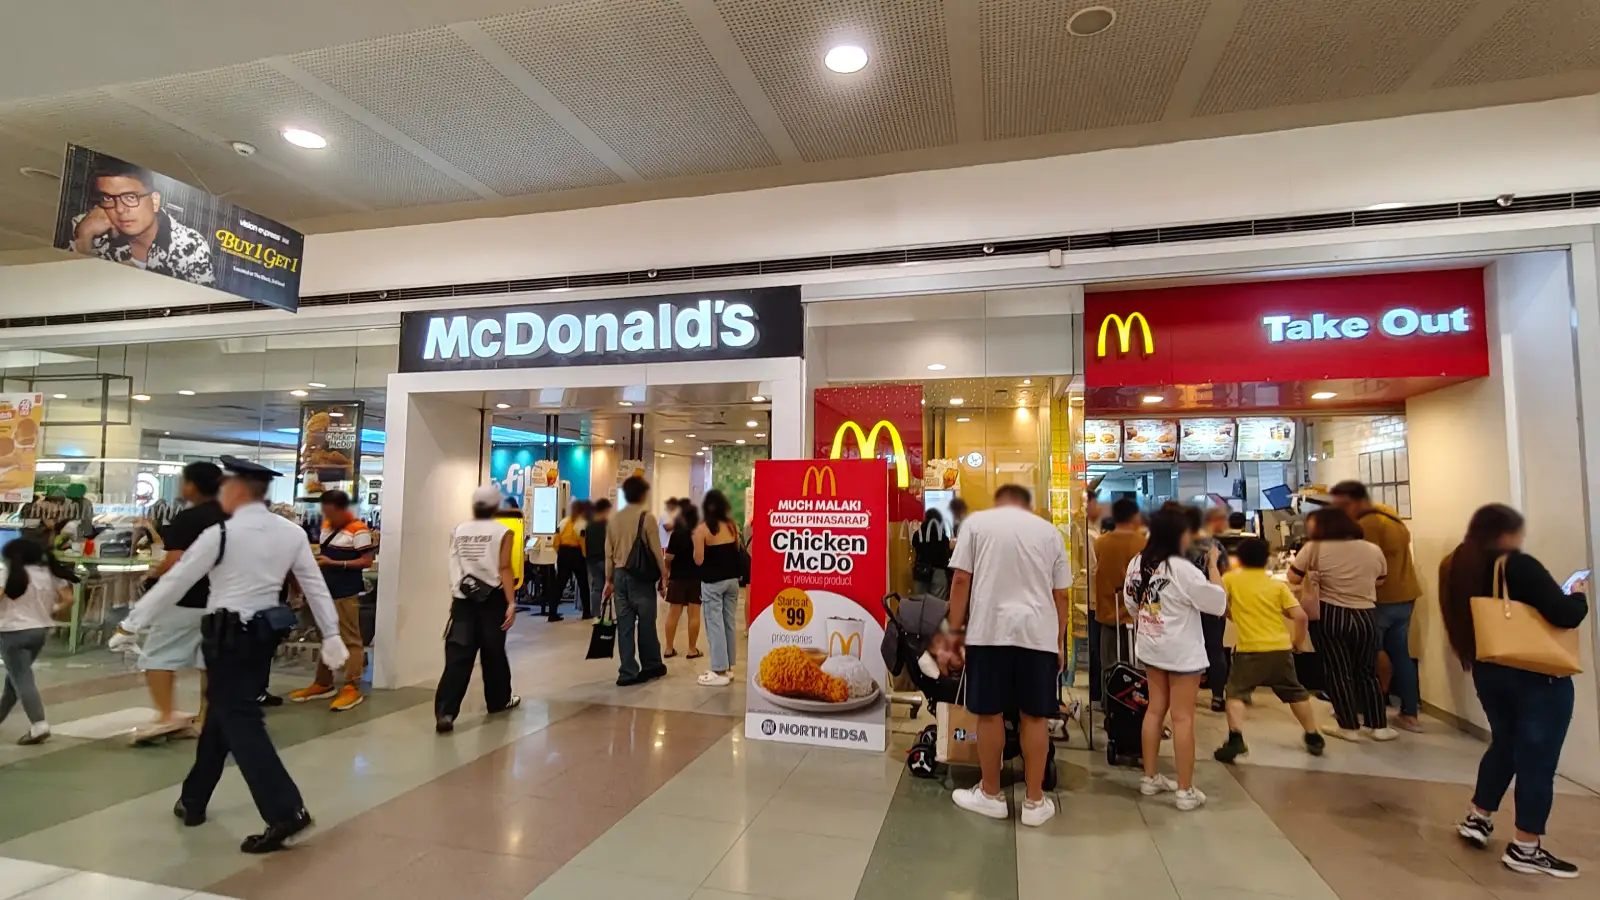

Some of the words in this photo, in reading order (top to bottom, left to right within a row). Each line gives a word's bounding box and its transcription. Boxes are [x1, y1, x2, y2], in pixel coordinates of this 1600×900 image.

[215, 229, 255, 256] BUY
[254, 243, 263, 259] 1
[263, 247, 292, 269] GET
[290, 258, 299, 273] 1
[423, 299, 757, 361] McDonald's
[1263, 313, 1370, 342] Take
[1381, 307, 1470, 336] Out
[777, 499, 814, 511] MUCH
[815, 499, 862, 512] MALAKI
[772, 514, 804, 525] MUCH
[806, 515, 867, 525] PINASARAP
[771, 529, 866, 553] Chicken
[784, 551, 852, 573] McDo
[793, 575, 823, 586] previous
[823, 576, 853, 588] product
[777, 595, 800, 607] Starts
[800, 597, 809, 608] at
[771, 633, 791, 644] price
[790, 634, 813, 645] varies
[779, 722, 829, 739] NORTH
[830, 727, 868, 743] EDSA
